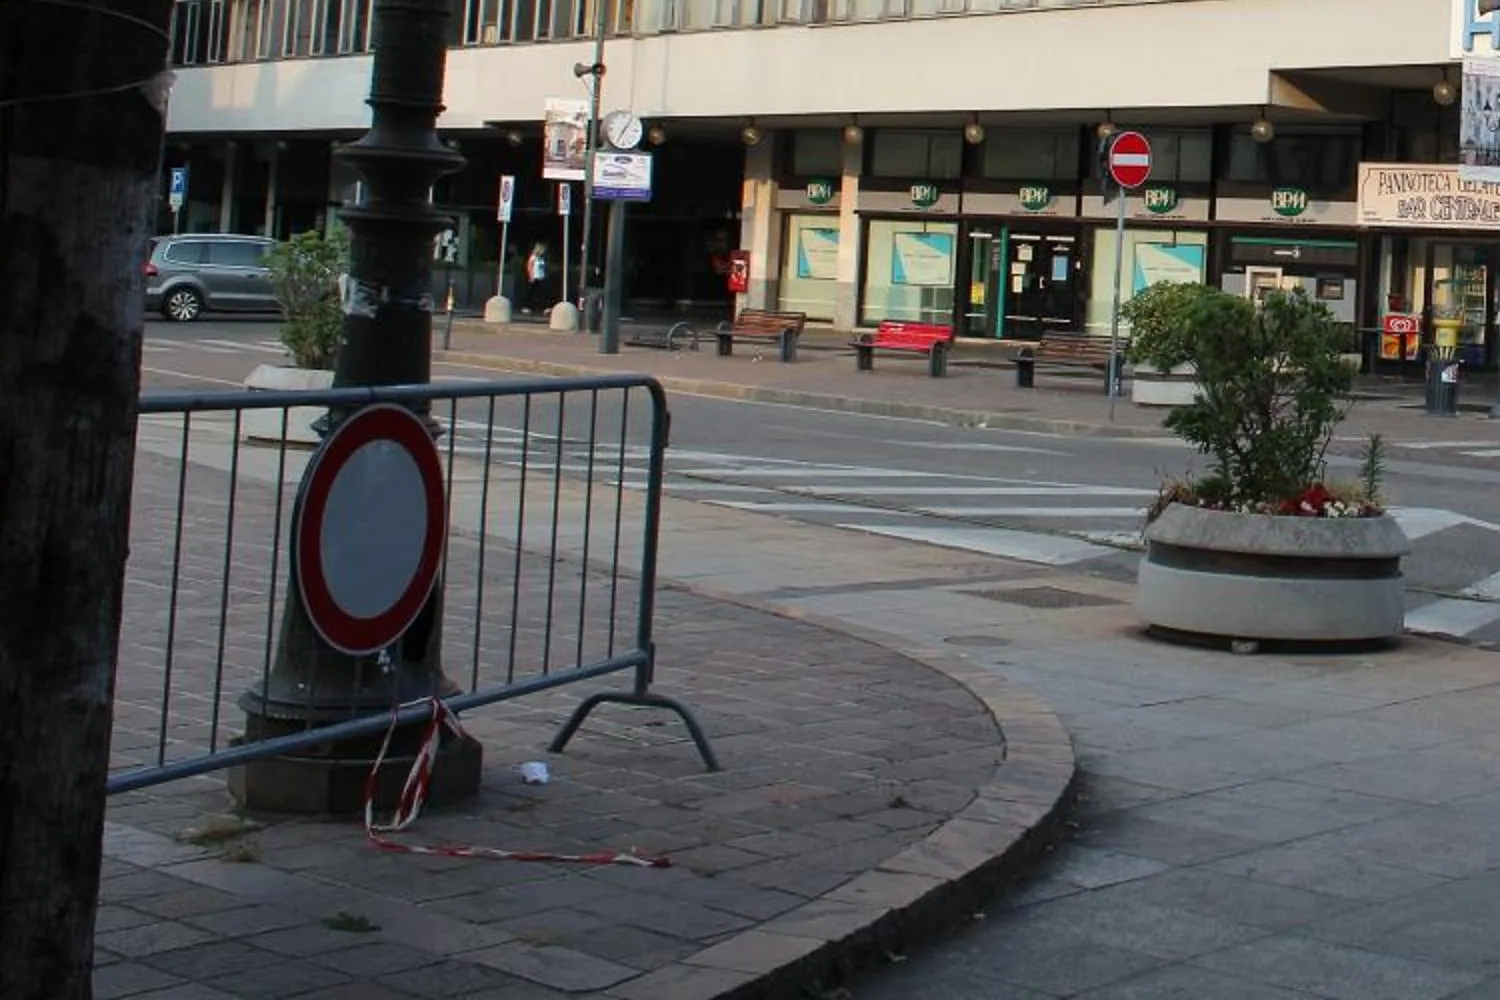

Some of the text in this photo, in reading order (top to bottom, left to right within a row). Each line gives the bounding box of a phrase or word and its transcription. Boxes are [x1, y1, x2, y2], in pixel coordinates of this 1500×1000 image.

[1378, 171, 1450, 197] PANINOTECA
[1397, 194, 1500, 222] BAR CENTRALE
